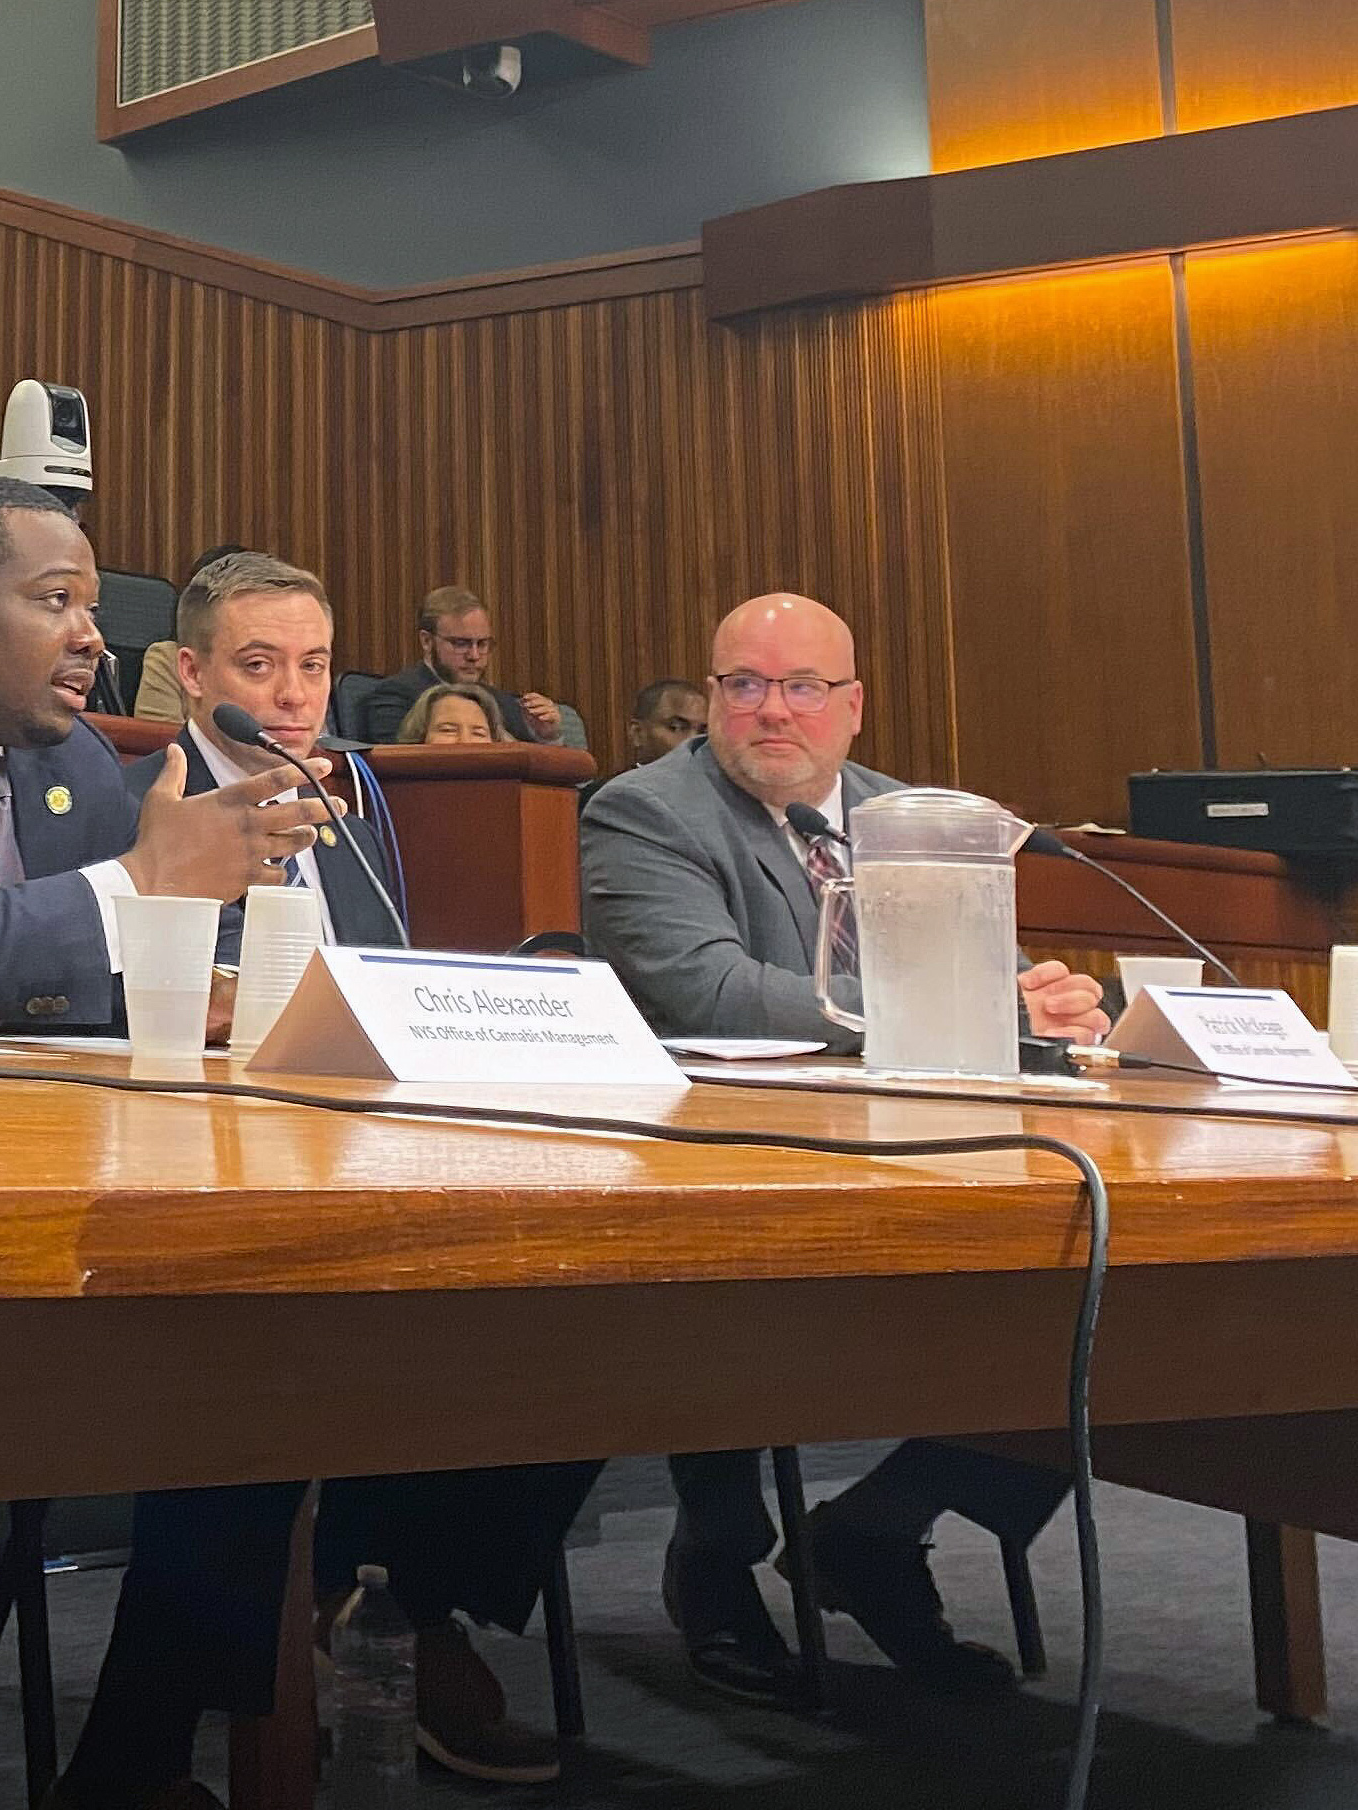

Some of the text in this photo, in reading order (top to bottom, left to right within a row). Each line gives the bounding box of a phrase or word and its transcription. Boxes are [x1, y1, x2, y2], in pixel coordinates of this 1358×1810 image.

[415, 986, 573, 1017] Chris Alexander
[409, 1026, 619, 1046] NYS Office of Cannabis Management
